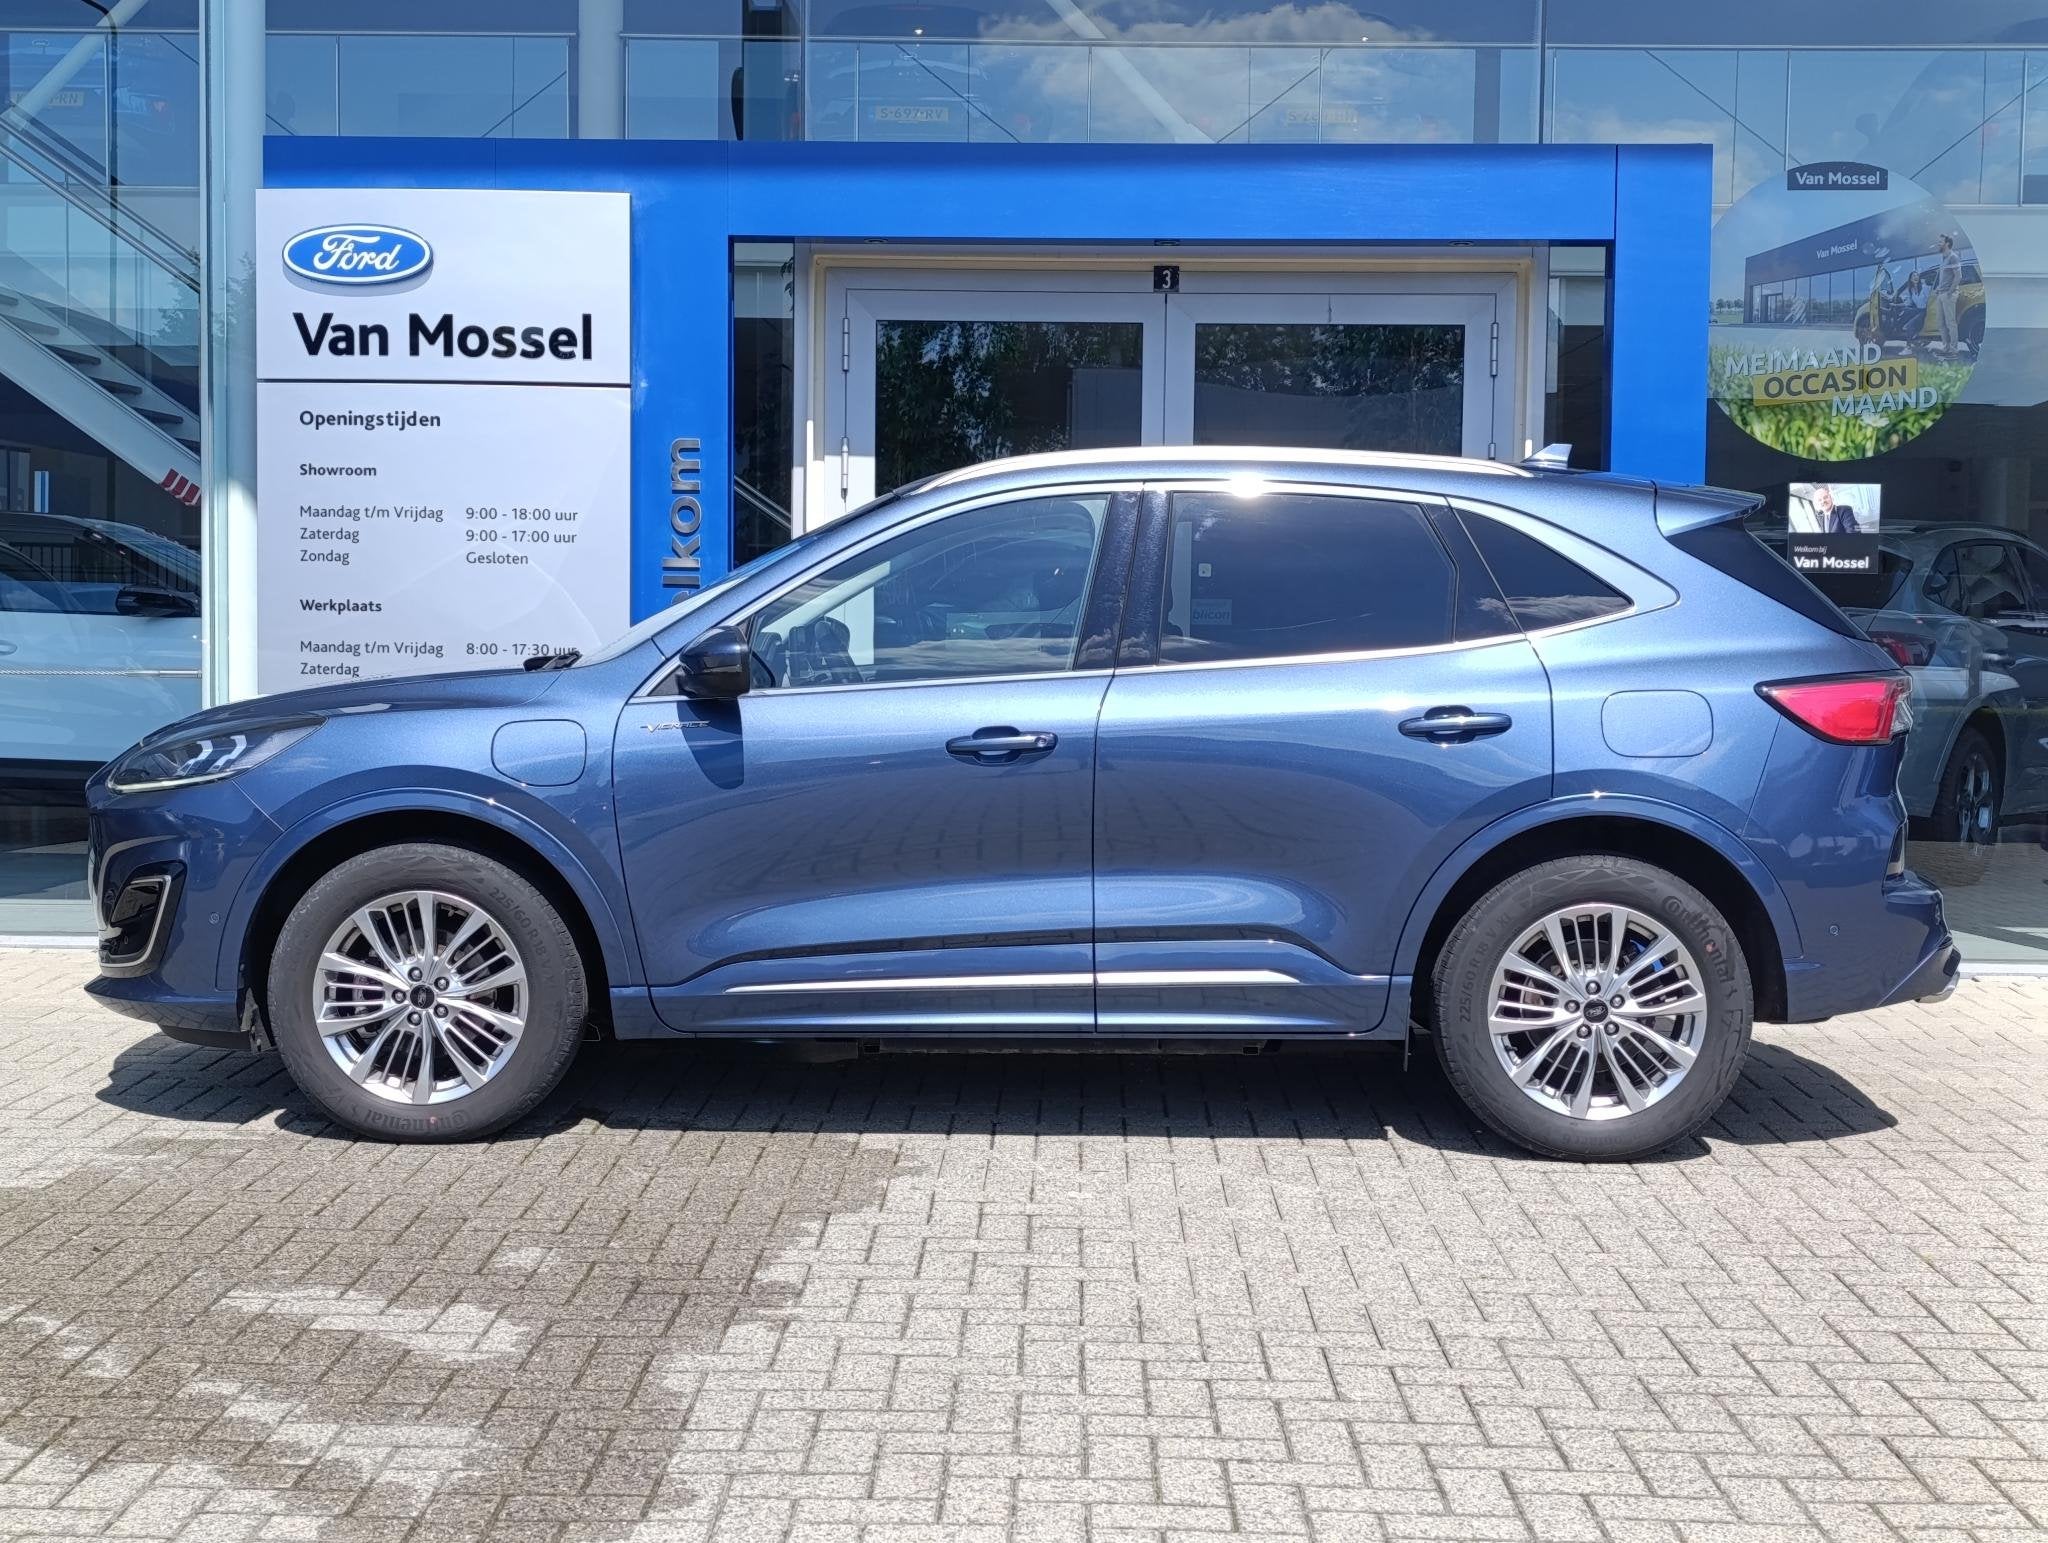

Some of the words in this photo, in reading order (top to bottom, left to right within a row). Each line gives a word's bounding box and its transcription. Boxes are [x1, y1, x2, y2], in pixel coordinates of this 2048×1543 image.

[1795, 171, 1824, 185] Van
[1828, 171, 1881, 185] Mossel
[312, 233, 403, 271] Ford
[1816, 248, 1830, 260] Van
[1830, 239, 1858, 256] Mossel
[1162, 269, 1171, 289] 3
[293, 312, 389, 357] Van
[409, 313, 592, 361] Mossel
[1725, 343, 1883, 379] MEIMAAND
[1763, 365, 1908, 399] OCCASION
[1831, 386, 1939, 418] MAAND
[299, 410, 441, 432] Openingstijden
[299, 462, 377, 477] Showroom
[299, 505, 361, 522] Maandag
[364, 505, 390, 519] t/m
[393, 505, 444, 523] Vrijdag
[465, 507, 498, 520] 9:00
[511, 507, 551, 521] 18:00
[555, 511, 579, 521] uur
[299, 528, 360, 544] Zaterdag
[465, 529, 498, 542] 9:00
[511, 530, 550, 543] 17:00
[554, 534, 578, 544] uur
[299, 550, 350, 566] Zondag
[465, 551, 529, 565] Gesloten
[1793, 545, 1819, 553] Welkom
[1793, 556, 1819, 569] Van
[1822, 556, 1870, 569] Mossel
[299, 599, 383, 616] Werkplaats
[299, 640, 361, 657] Maandag
[364, 640, 390, 654] t/m
[393, 641, 444, 659] Vrijdag
[466, 642, 498, 656] 8:00
[511, 643, 550, 656] 17:30
[299, 662, 360, 678] Zaterdag
